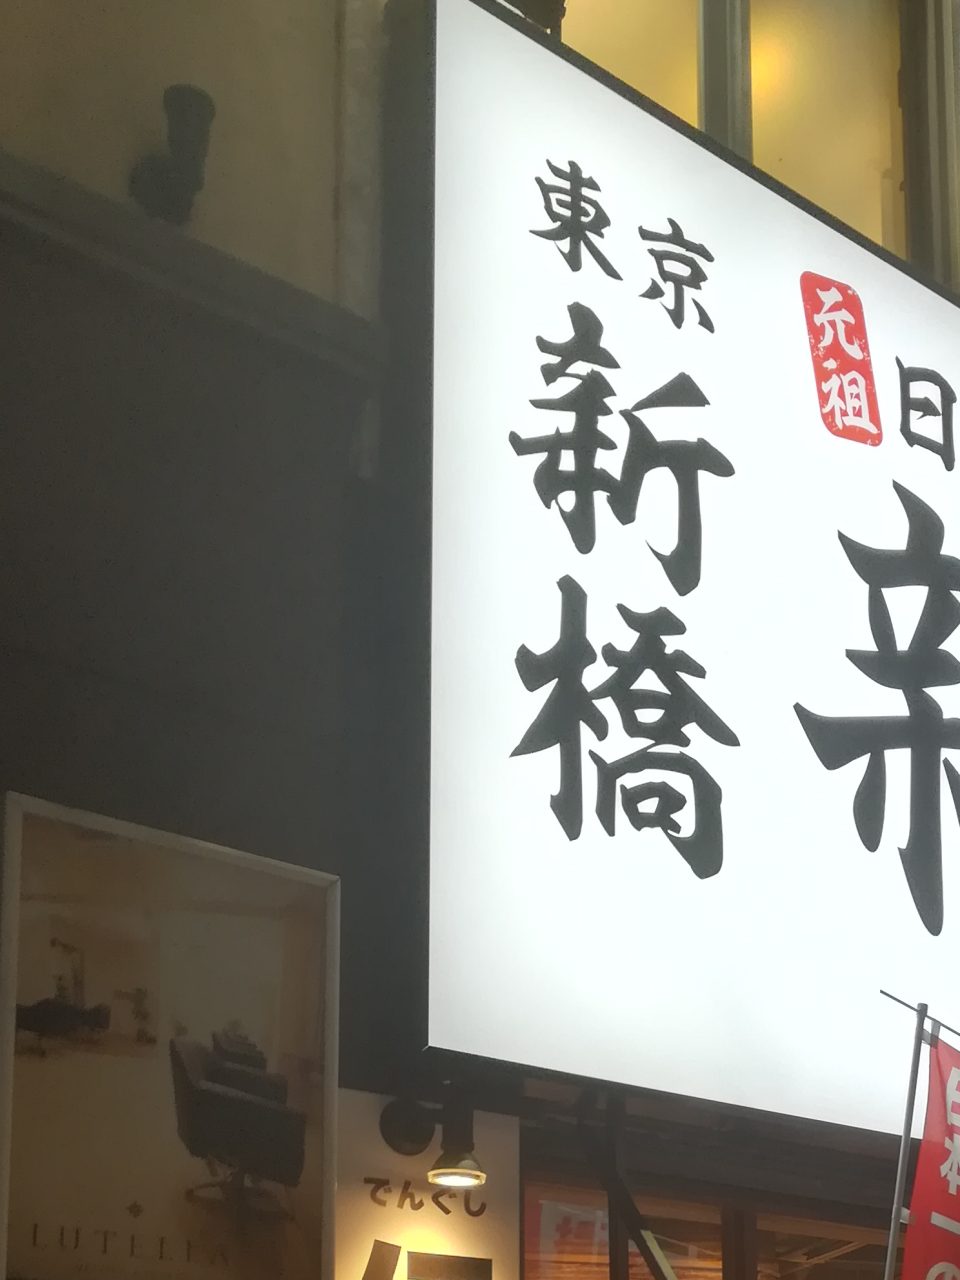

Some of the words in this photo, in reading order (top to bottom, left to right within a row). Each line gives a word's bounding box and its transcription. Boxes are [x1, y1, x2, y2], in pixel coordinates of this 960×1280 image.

[529, 159, 715, 333] 東京
[812, 286, 879, 435] 元祖
[508, 302, 741, 879] 新橋
[363, 1174, 488, 1218] でんぐし
